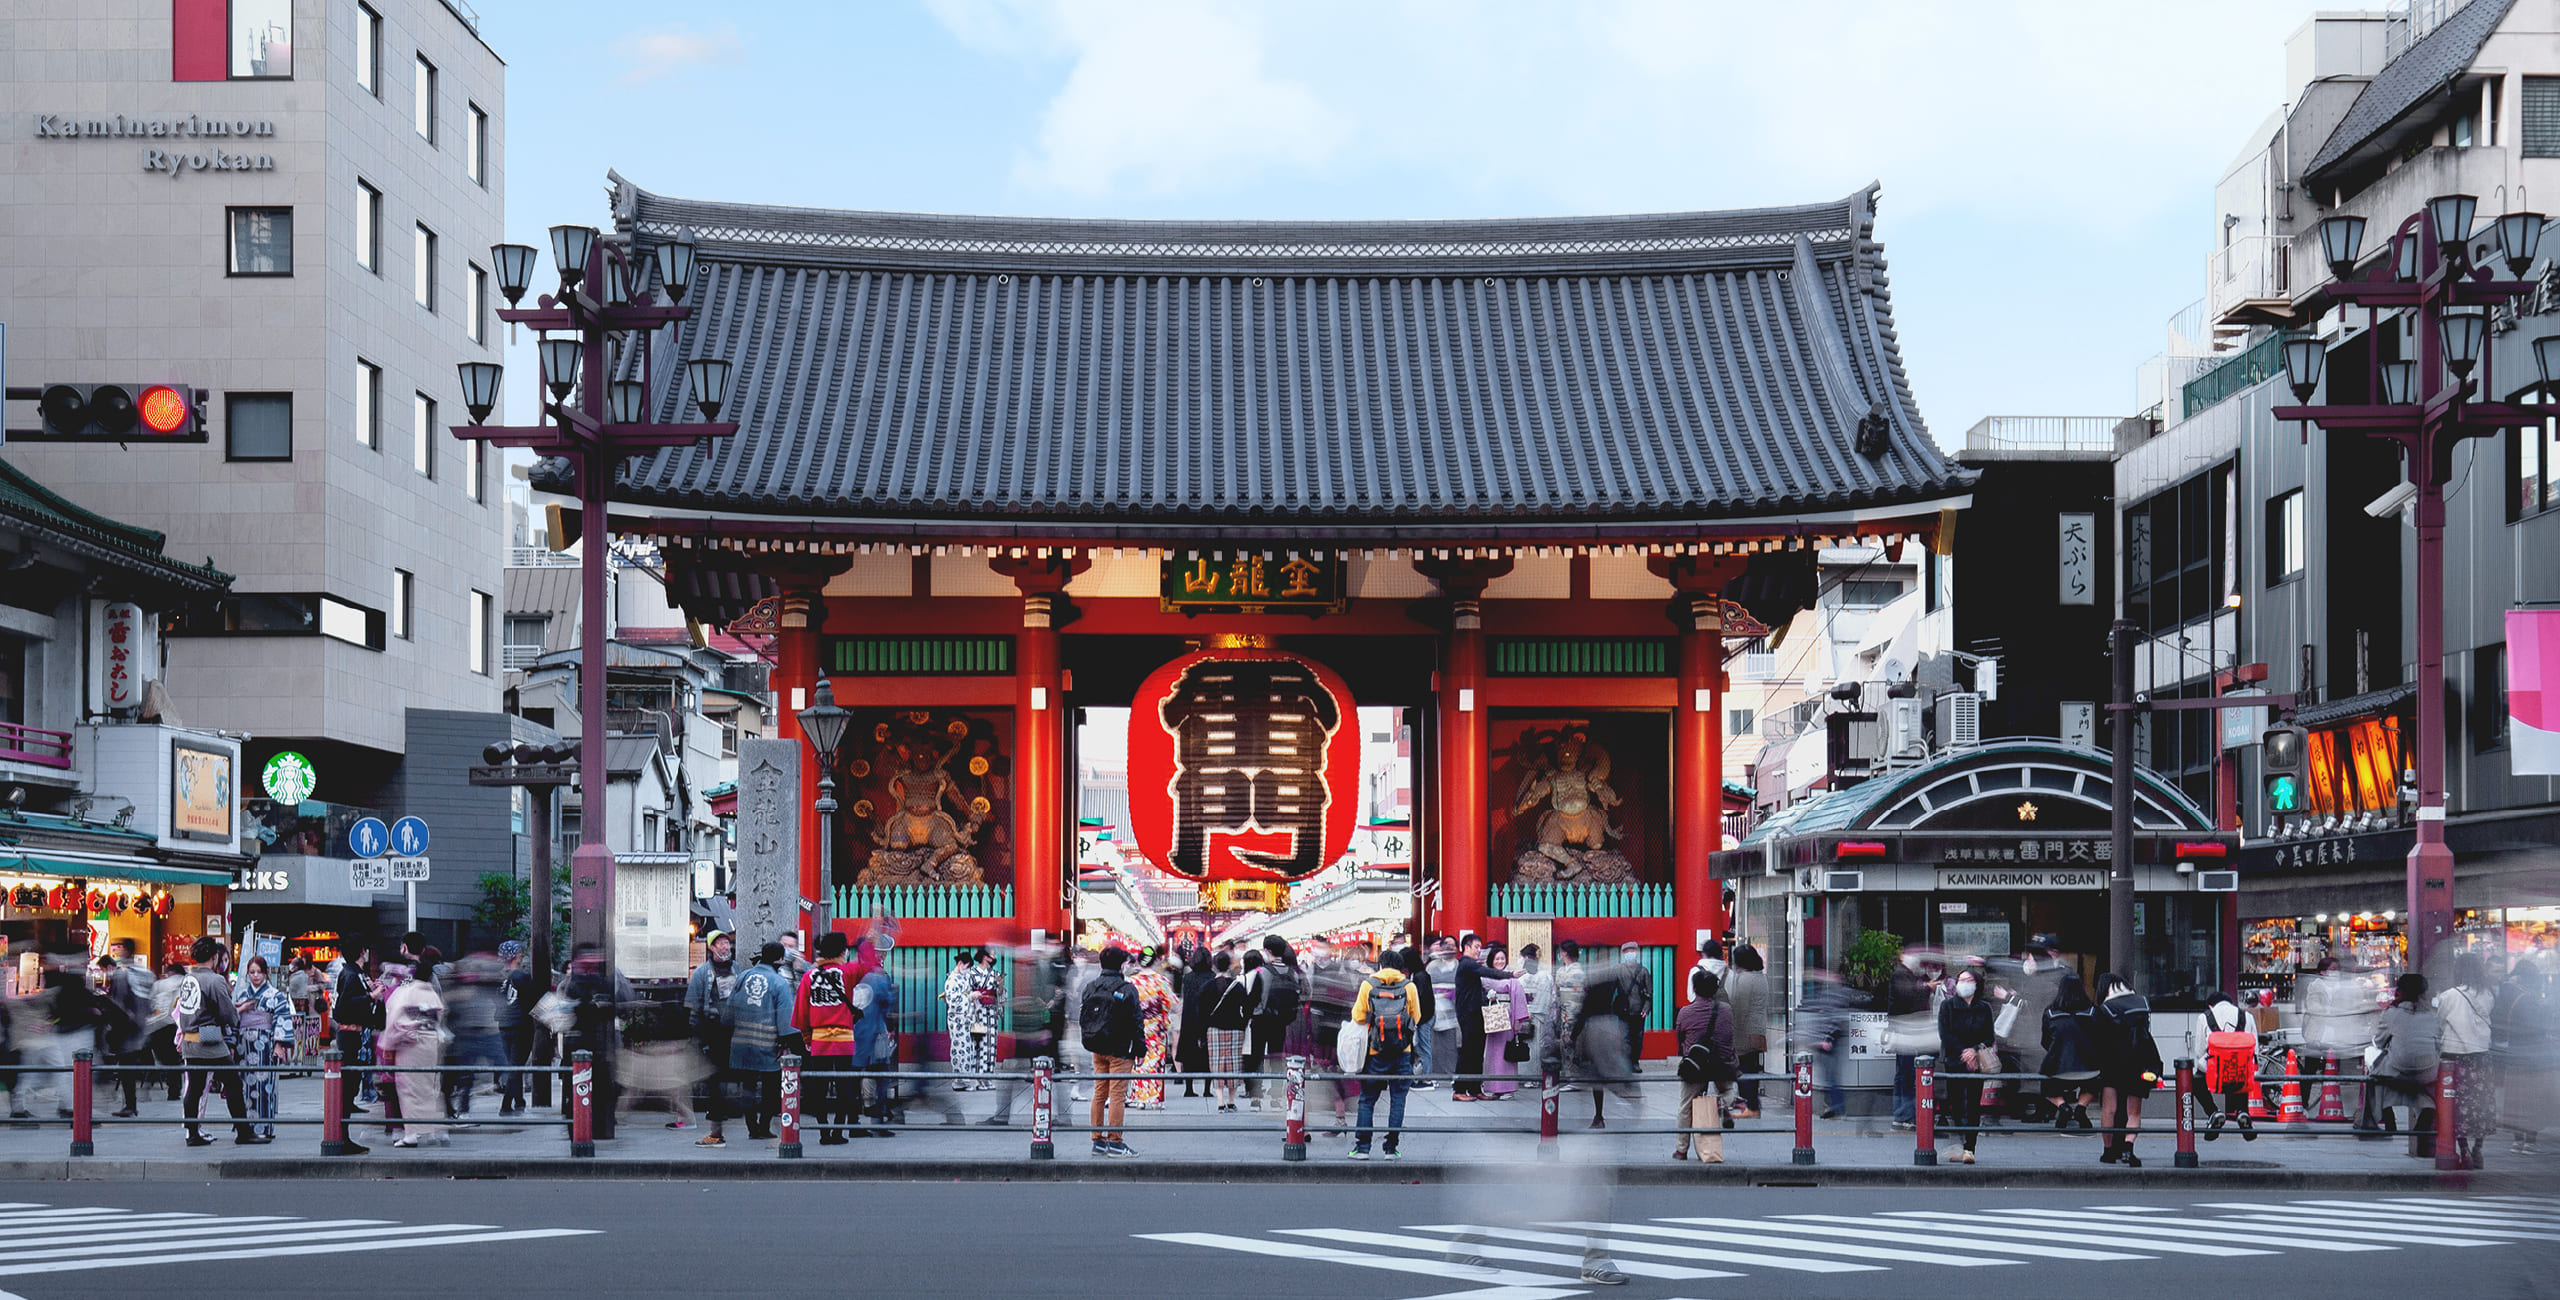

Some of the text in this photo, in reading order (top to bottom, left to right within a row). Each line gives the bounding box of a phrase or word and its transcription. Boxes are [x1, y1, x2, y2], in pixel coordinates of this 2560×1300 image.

[33, 113, 275, 138] Kaminarimon
[143, 147, 275, 177] Ryokan
[108, 621, 131, 702] 雷おこし
[2227, 724, 2250, 738] KOBAN
[1158, 656, 1341, 878] 雷門
[2019, 840, 2113, 861] 雷門交番
[1947, 873, 2096, 886] KAMINARIMON KOBAN
[1850, 1029, 1867, 1038] 死亡
[1850, 1045, 1868, 1054] 負傷
